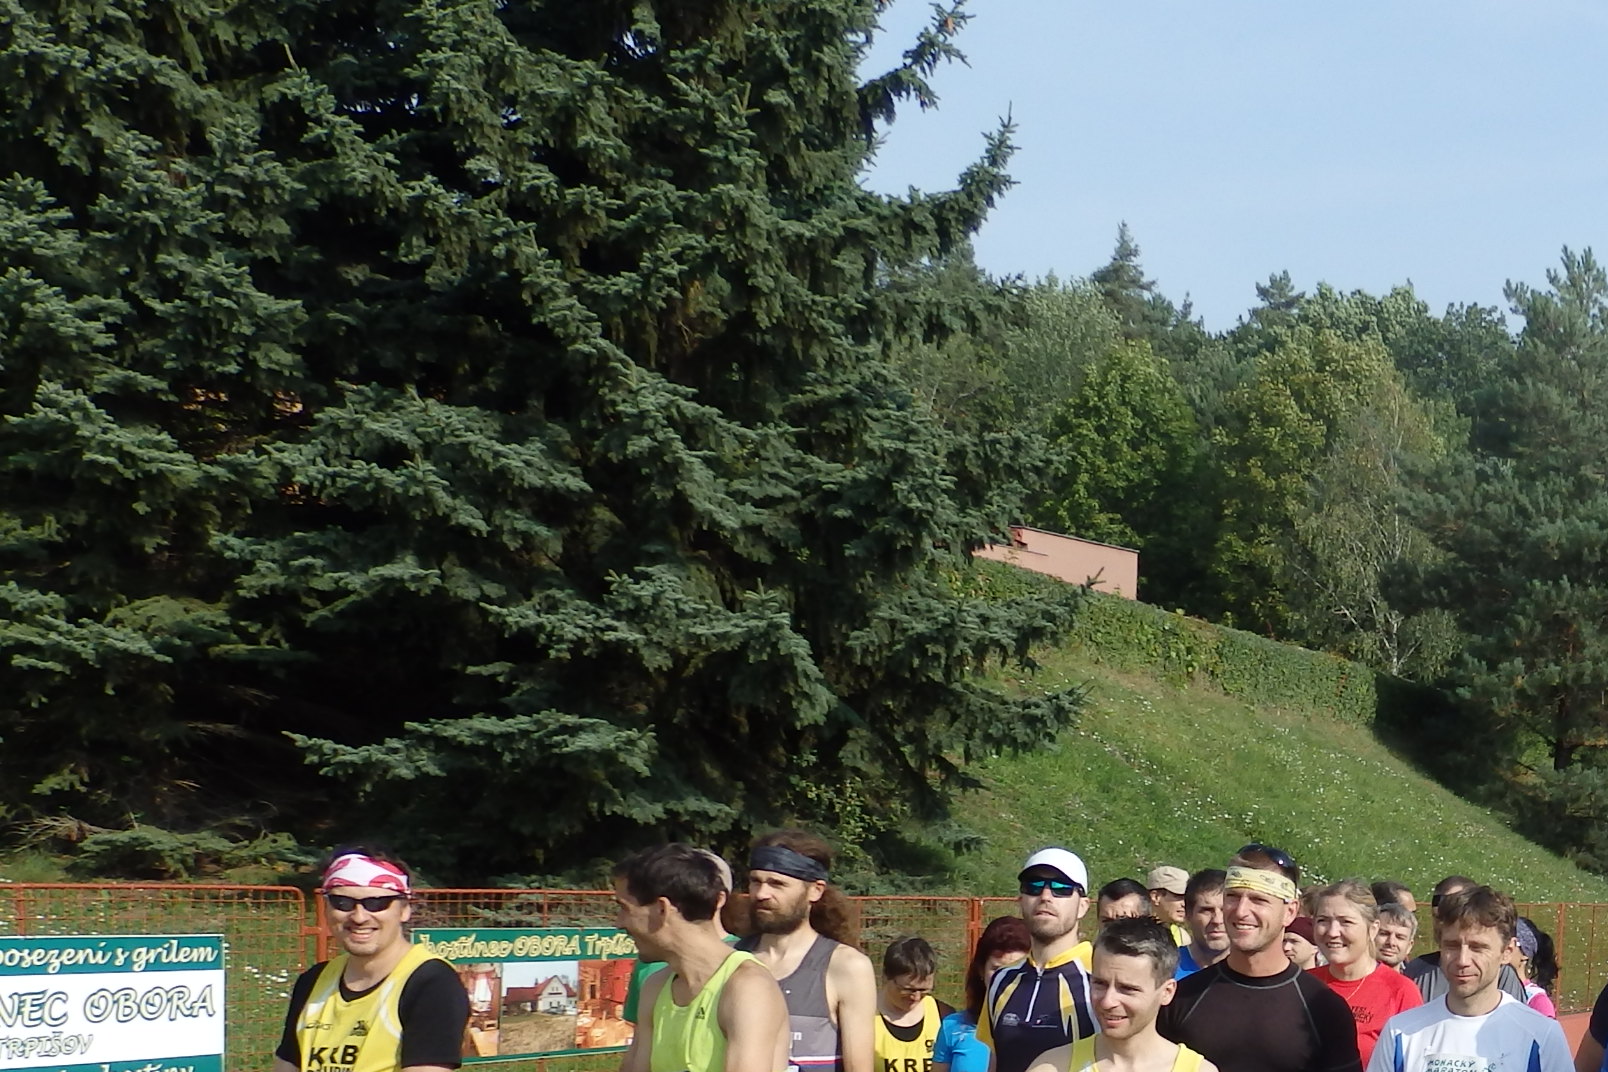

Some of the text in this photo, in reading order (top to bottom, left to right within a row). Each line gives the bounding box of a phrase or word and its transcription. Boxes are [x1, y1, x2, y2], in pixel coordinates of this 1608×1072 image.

[115, 948, 130, 966] s
[514, 934, 581, 957] OBORA
[84, 985, 216, 1024] OBORA
